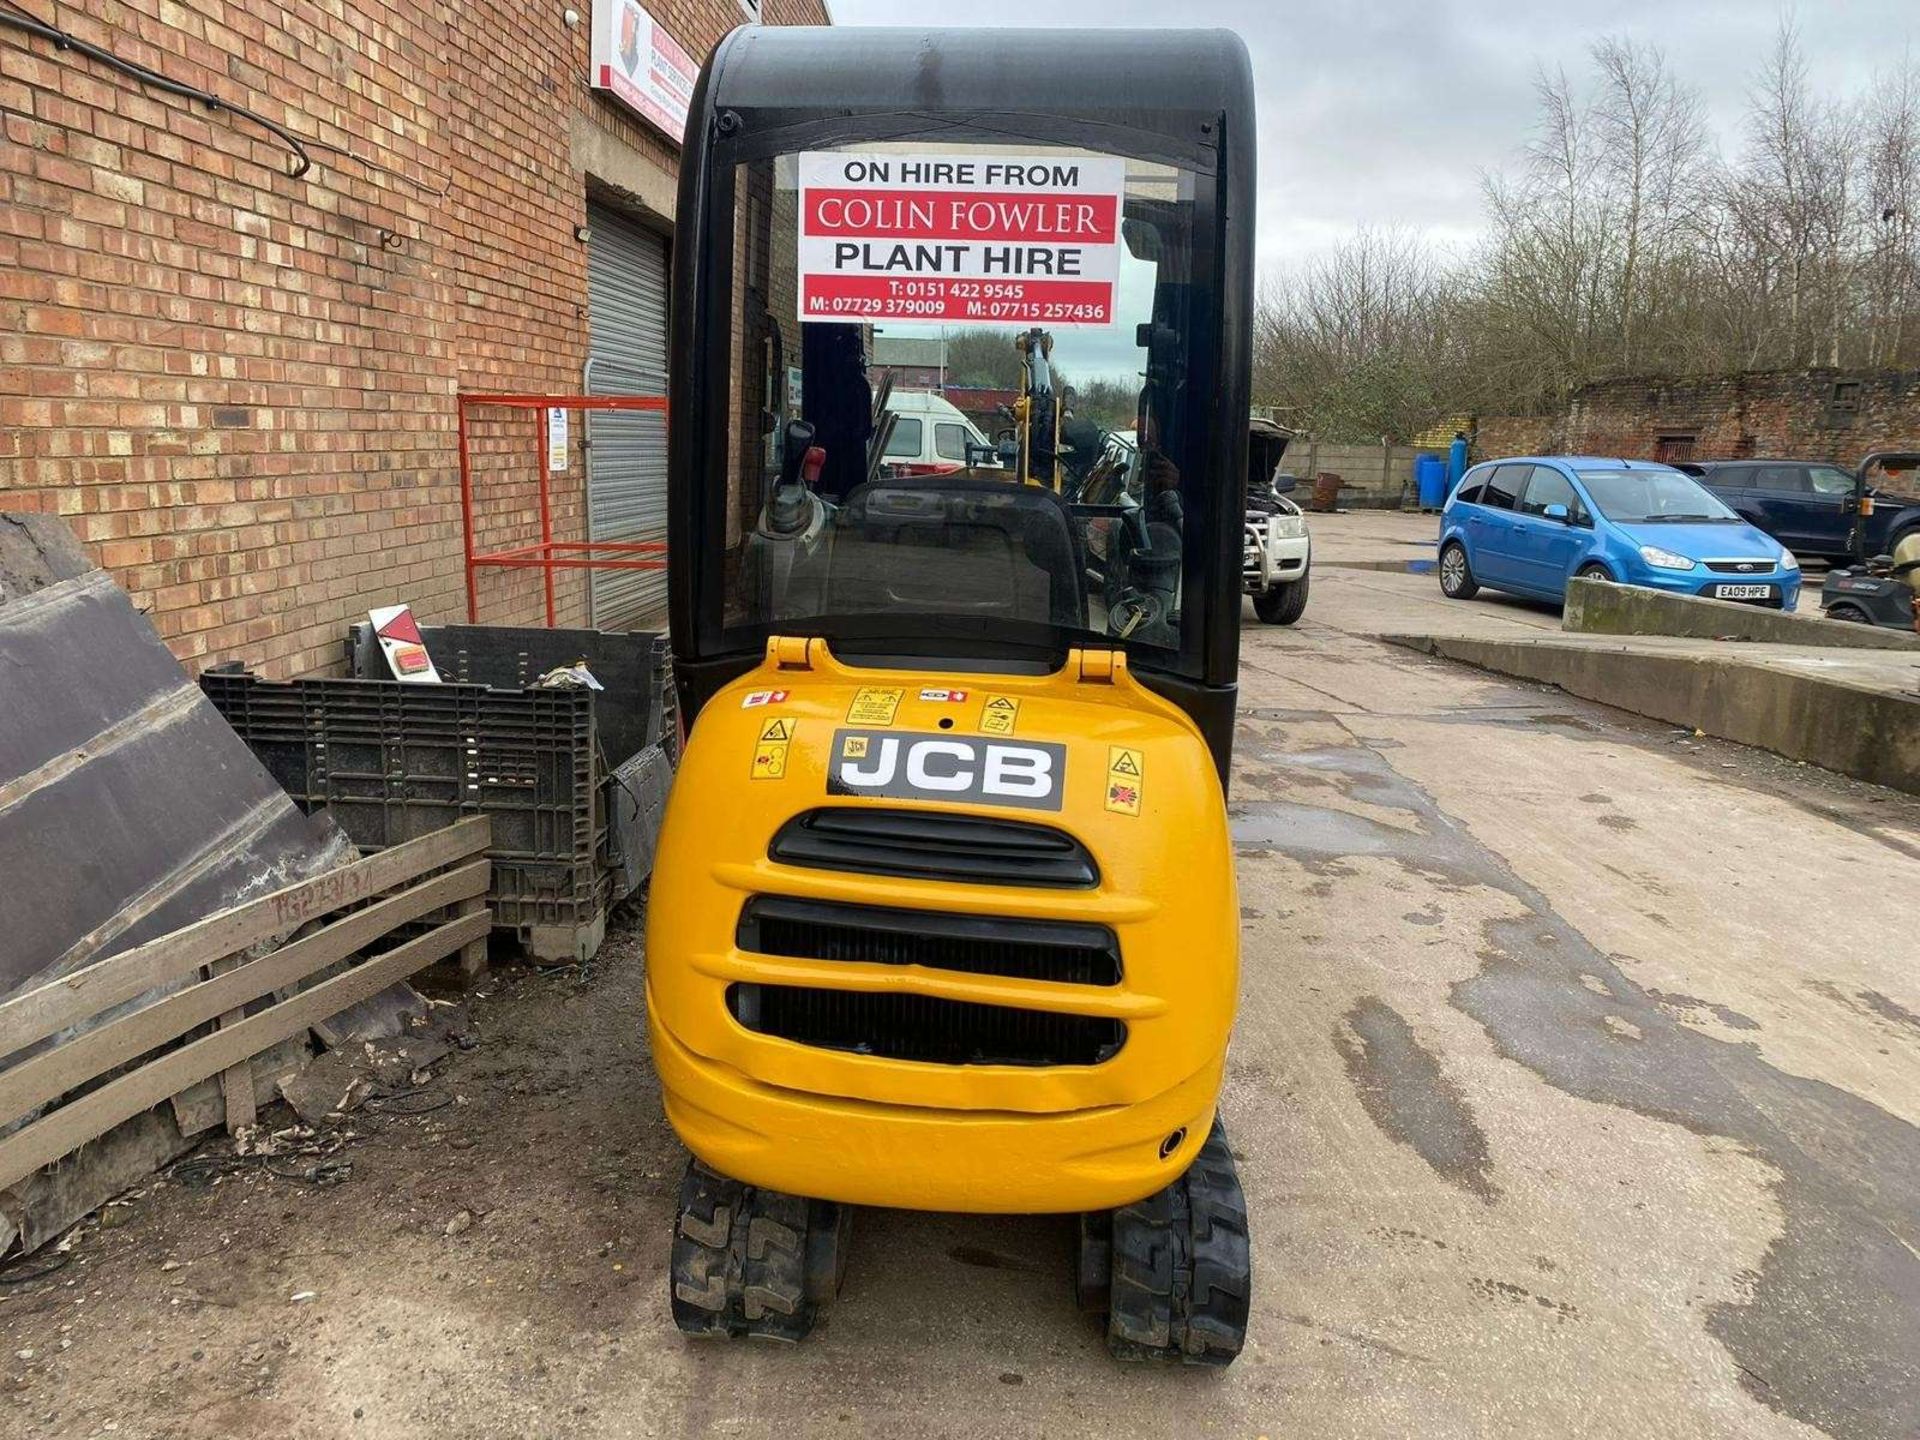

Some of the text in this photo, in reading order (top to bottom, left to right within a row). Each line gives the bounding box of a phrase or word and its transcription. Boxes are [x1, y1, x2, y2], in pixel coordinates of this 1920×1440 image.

[844, 161, 1079, 187] ON HIRE FROM
[817, 198, 1101, 234] COLIN FOWLER
[835, 243, 1082, 275] PLANT HIRE
[889, 280, 1024, 299] T: 0151 422 9545
[809, 296, 1105, 319] M: 07729 379009 M: 07715 257436
[1721, 586, 1766, 597] EA09 HPE
[841, 738, 1052, 799] JCB
